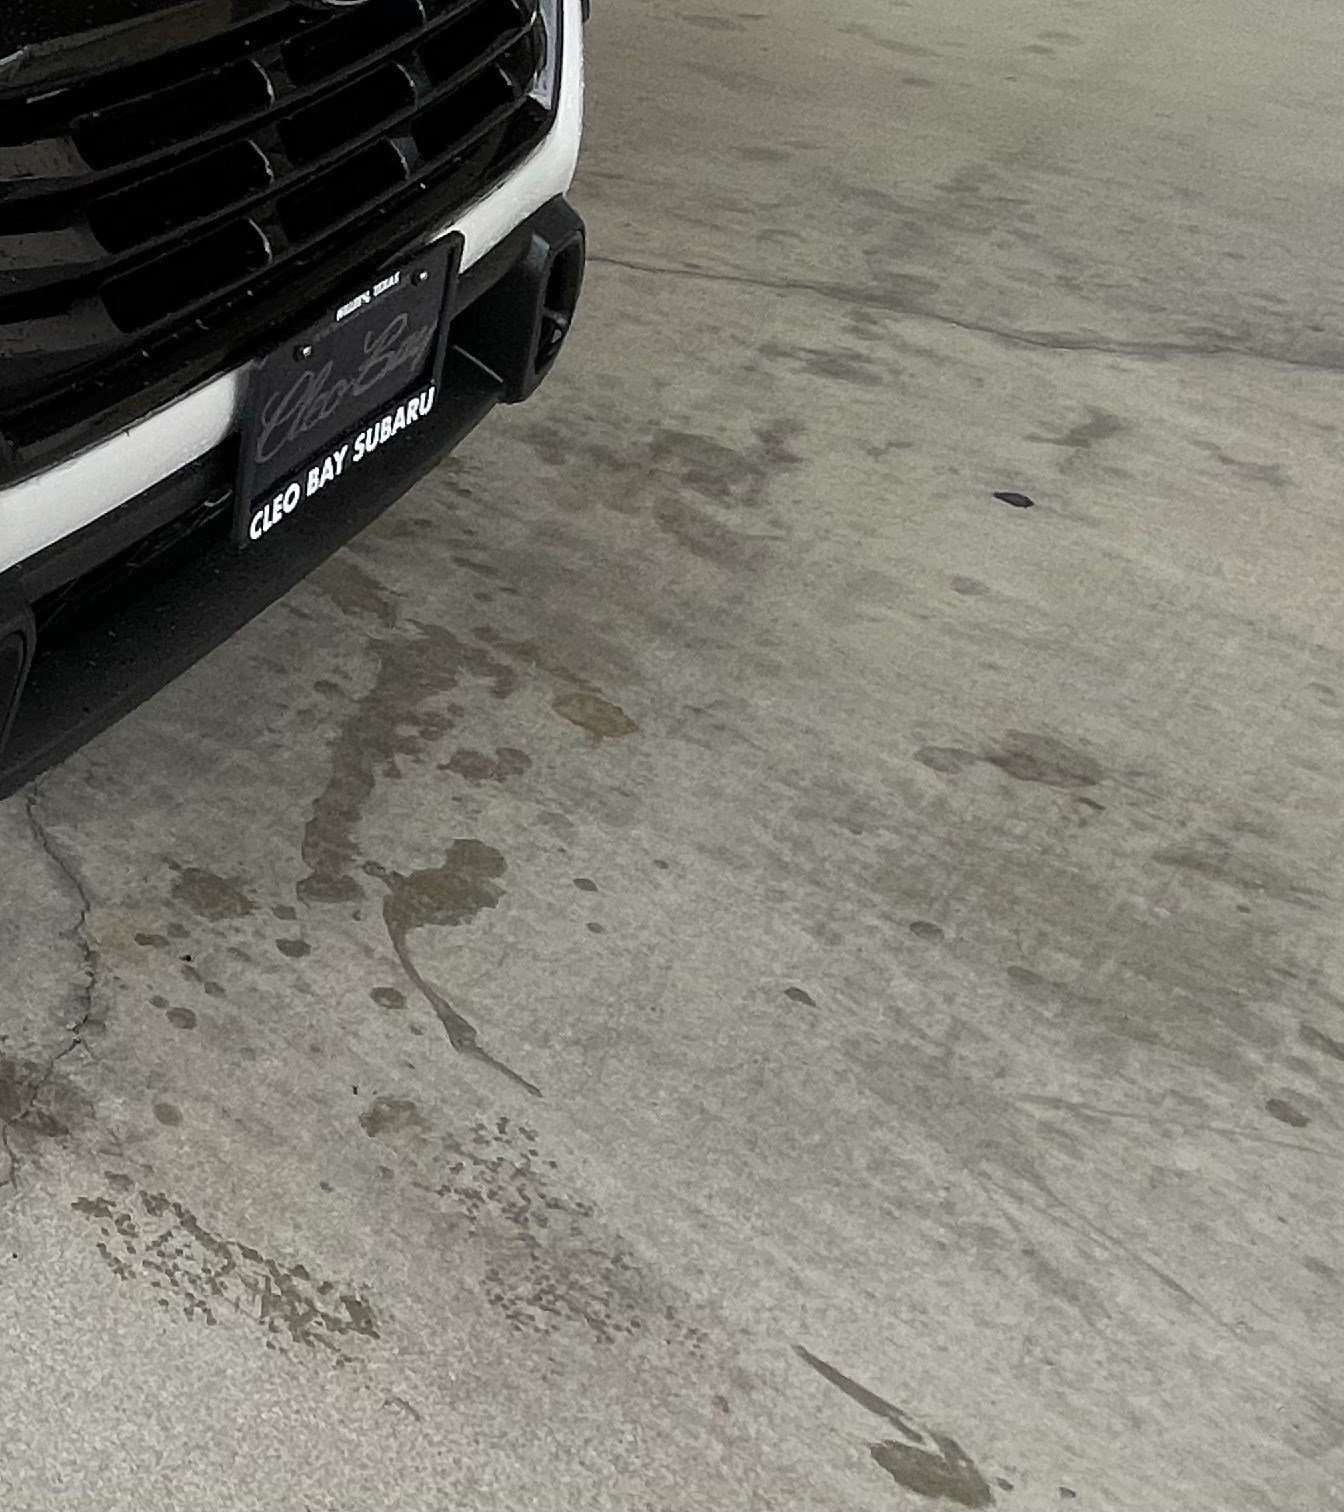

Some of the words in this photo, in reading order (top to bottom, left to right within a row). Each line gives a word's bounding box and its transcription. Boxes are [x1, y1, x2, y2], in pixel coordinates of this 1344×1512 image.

[249, 482, 301, 540] CLEO
[306, 444, 349, 497] BAY
[352, 386, 436, 462] SUBARU
